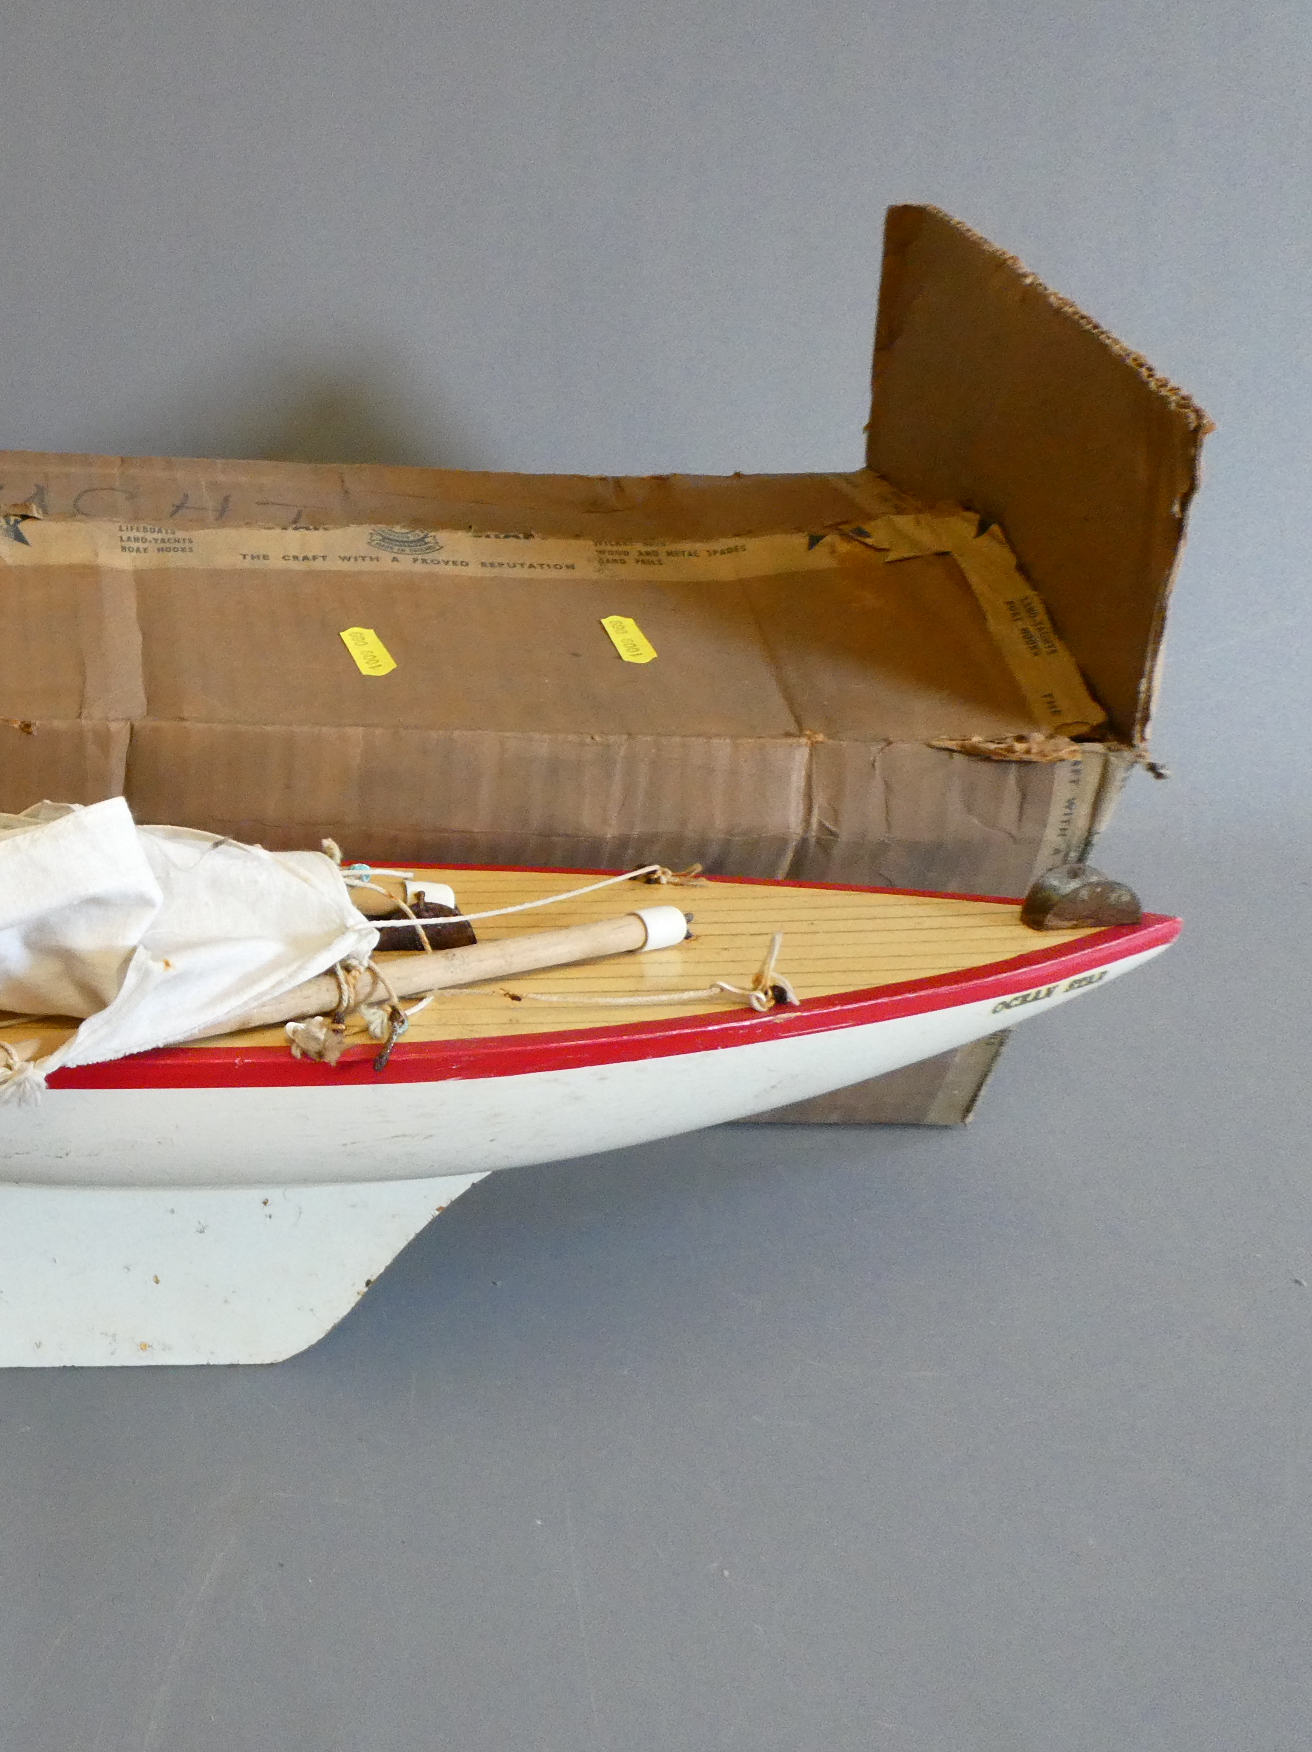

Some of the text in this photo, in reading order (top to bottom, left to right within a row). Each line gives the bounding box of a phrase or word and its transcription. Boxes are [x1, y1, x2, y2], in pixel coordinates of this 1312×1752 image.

[240, 553, 271, 562] THE
[281, 554, 329, 563] CRAFT
[338, 555, 381, 564] WITH
[412, 556, 470, 568] PROVED
[480, 560, 576, 571] REPUTATION
